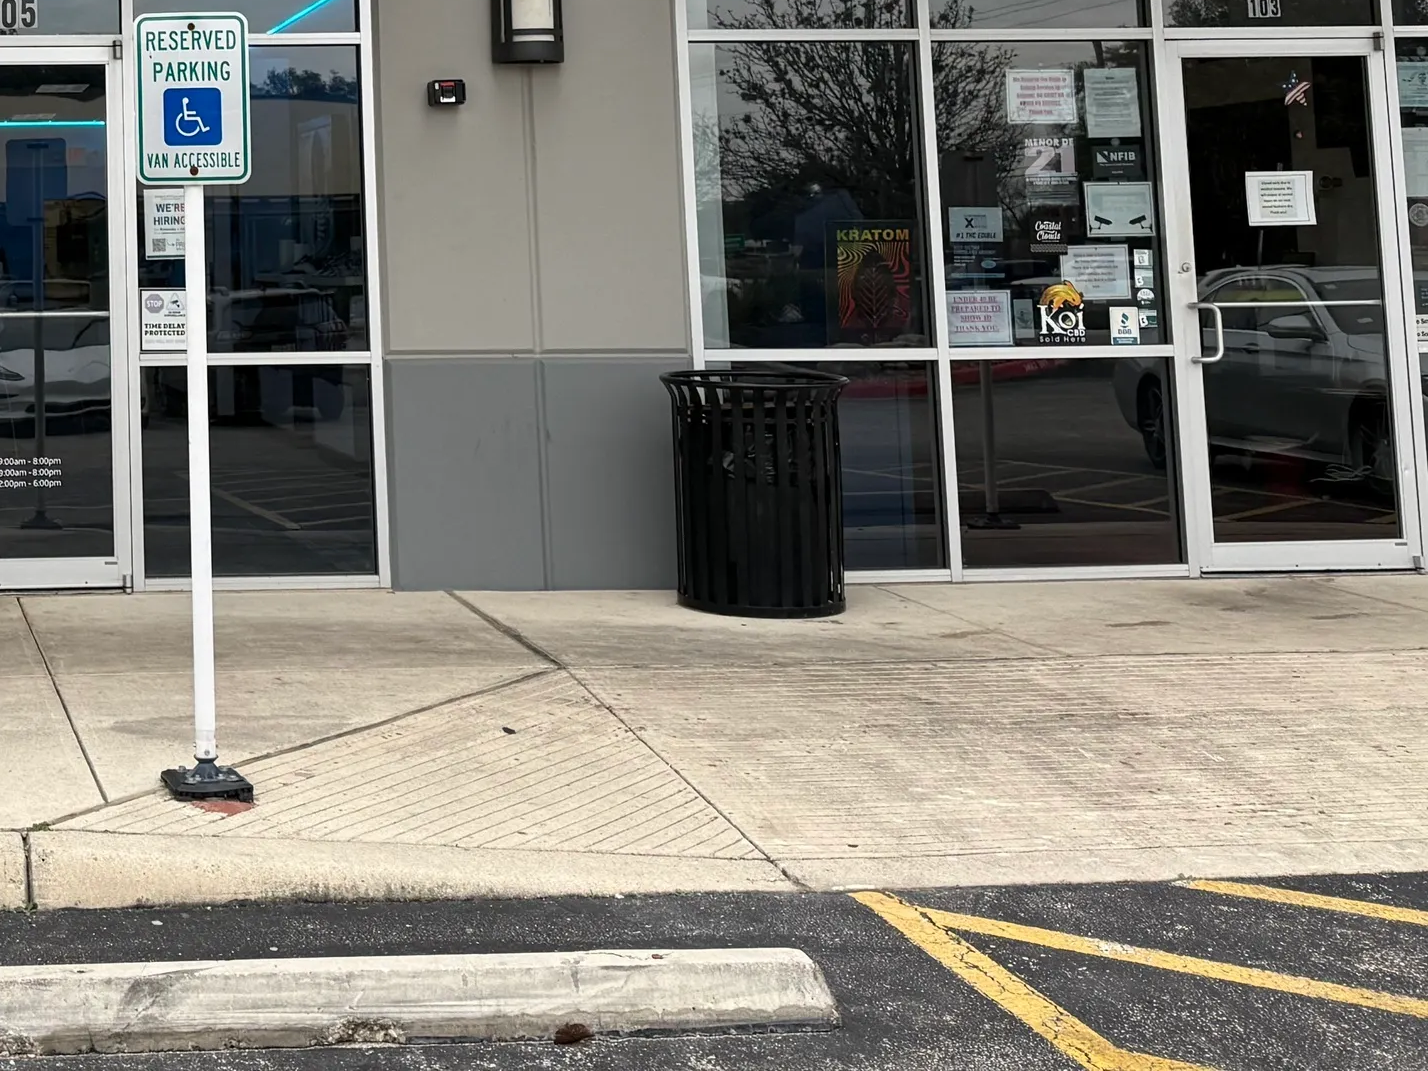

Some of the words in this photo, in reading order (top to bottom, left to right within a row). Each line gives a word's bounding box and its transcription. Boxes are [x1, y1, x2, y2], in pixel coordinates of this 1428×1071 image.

[145, 30, 237, 51] RESERVED
[153, 60, 231, 82] PARKING
[147, 153, 169, 168] VAN
[174, 152, 241, 168] ACCESSIBLE
[1025, 146, 1076, 175] 21
[1110, 151, 1136, 162] NFIB
[155, 203, 185, 213] WE'RE
[836, 228, 910, 241] KRATOM
[146, 300, 163, 308] STOP
[1036, 303, 1086, 334] Koi
[1067, 329, 1086, 337] CBD
[1039, 335, 1061, 343] Sold
[1063, 335, 1086, 343] Here
[32, 457, 62, 467] 8:00pm
[32, 468, 62, 478] 8:00pm
[33, 479, 62, 489] 6:00pm
